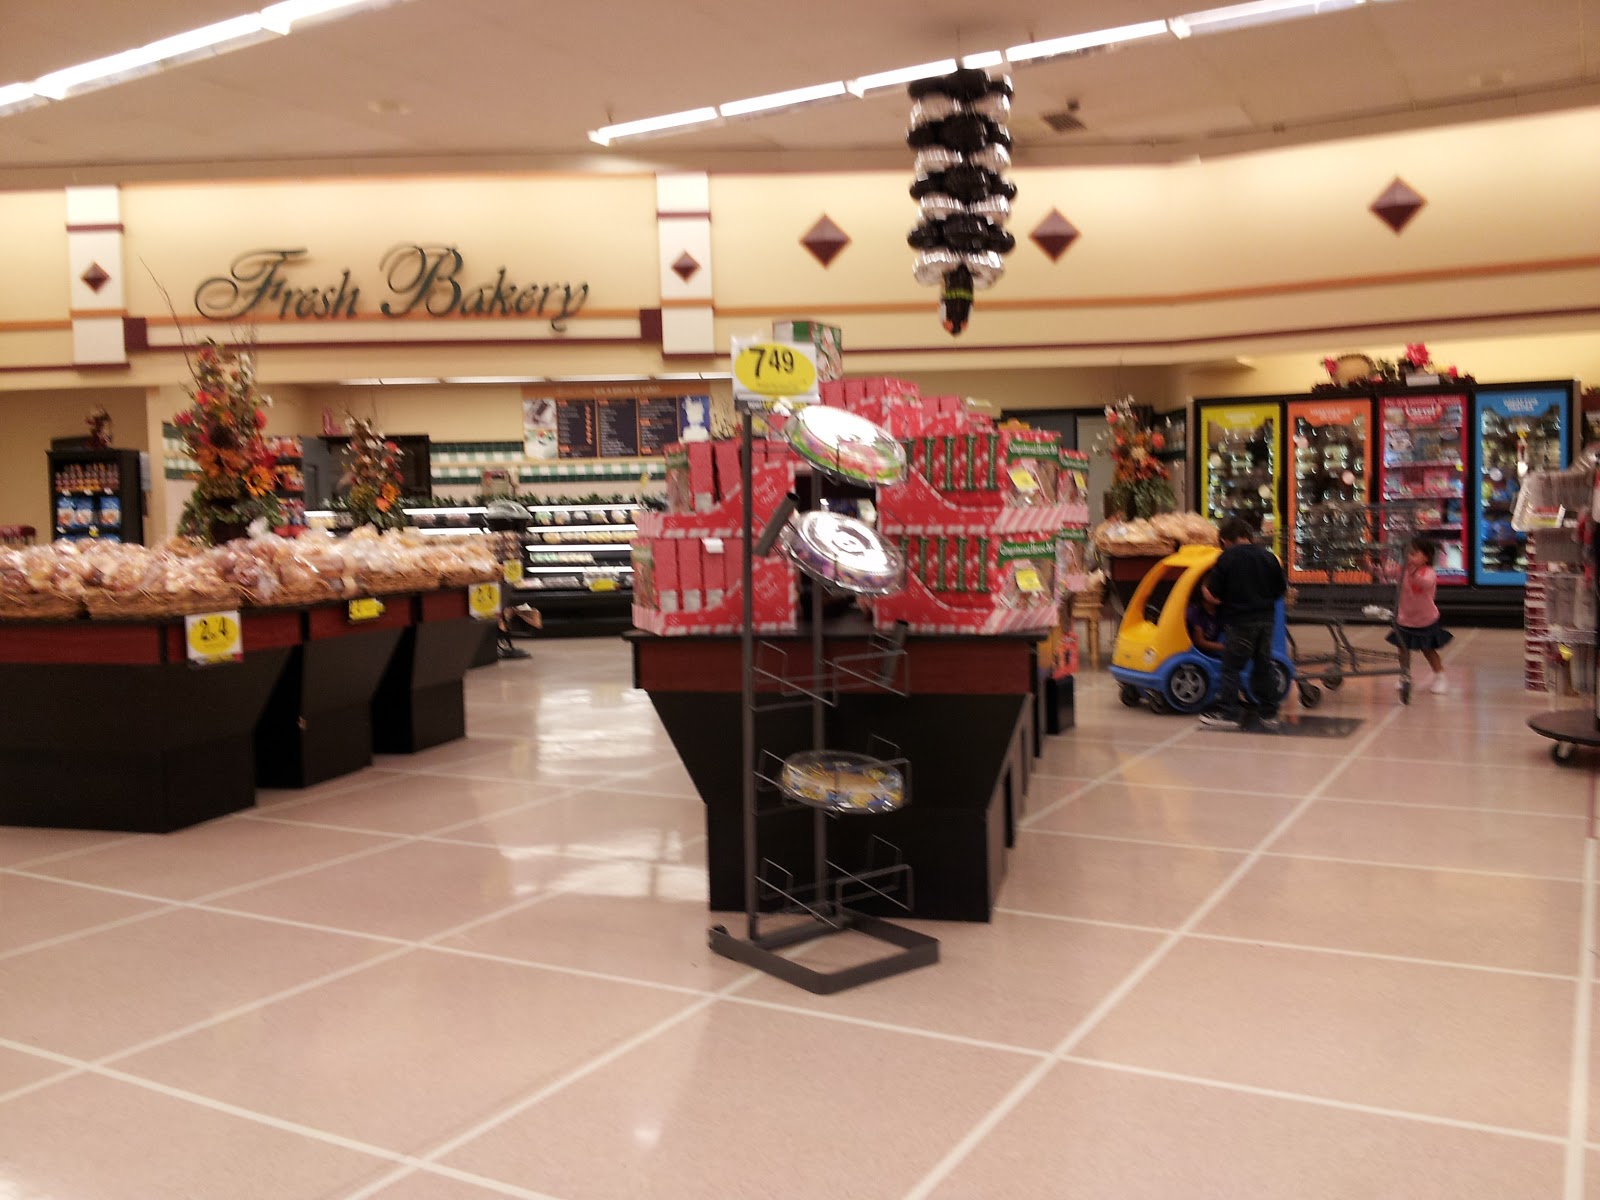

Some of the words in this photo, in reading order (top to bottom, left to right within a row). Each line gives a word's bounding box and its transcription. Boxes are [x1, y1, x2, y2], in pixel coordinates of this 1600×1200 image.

[194, 246, 362, 320] Fresh
[378, 241, 590, 334] Bakery
[748, 347, 795, 378] 749
